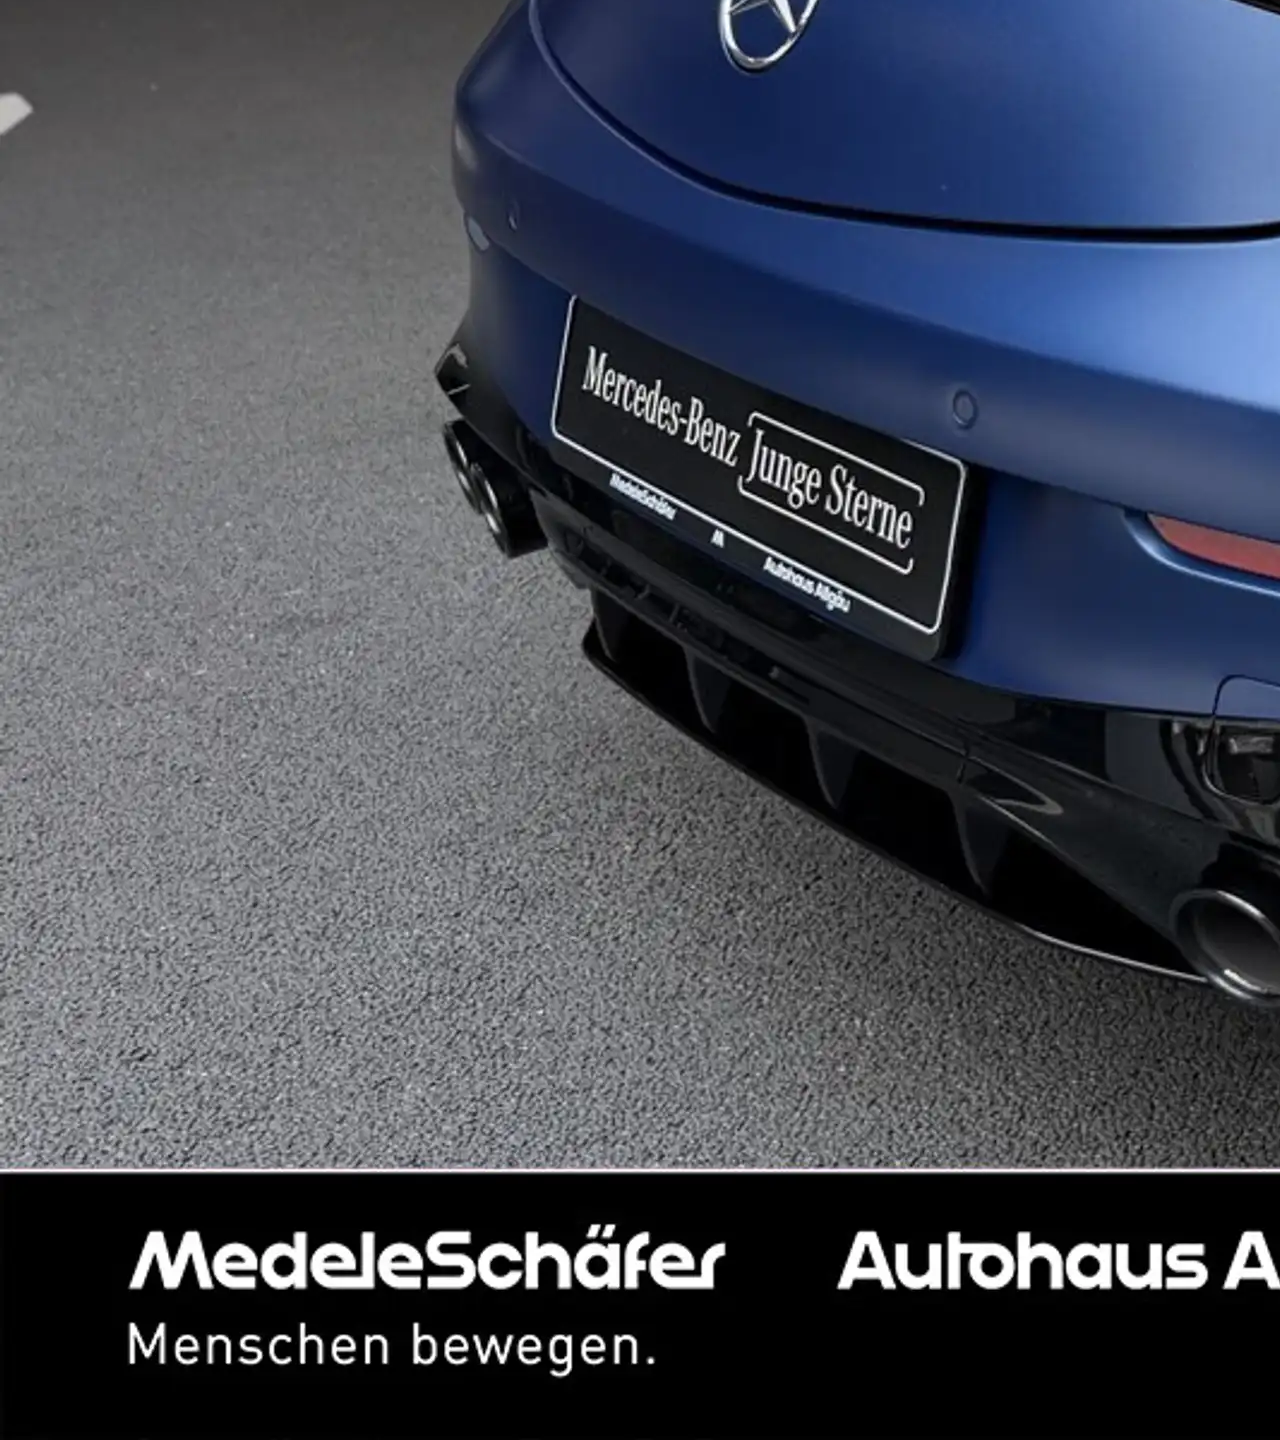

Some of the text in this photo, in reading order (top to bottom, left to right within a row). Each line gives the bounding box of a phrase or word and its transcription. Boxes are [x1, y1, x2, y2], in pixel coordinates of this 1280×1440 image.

[581, 346, 742, 467] Mercedes-Benz
[746, 428, 822, 509] Junge
[825, 464, 914, 549] Sterne
